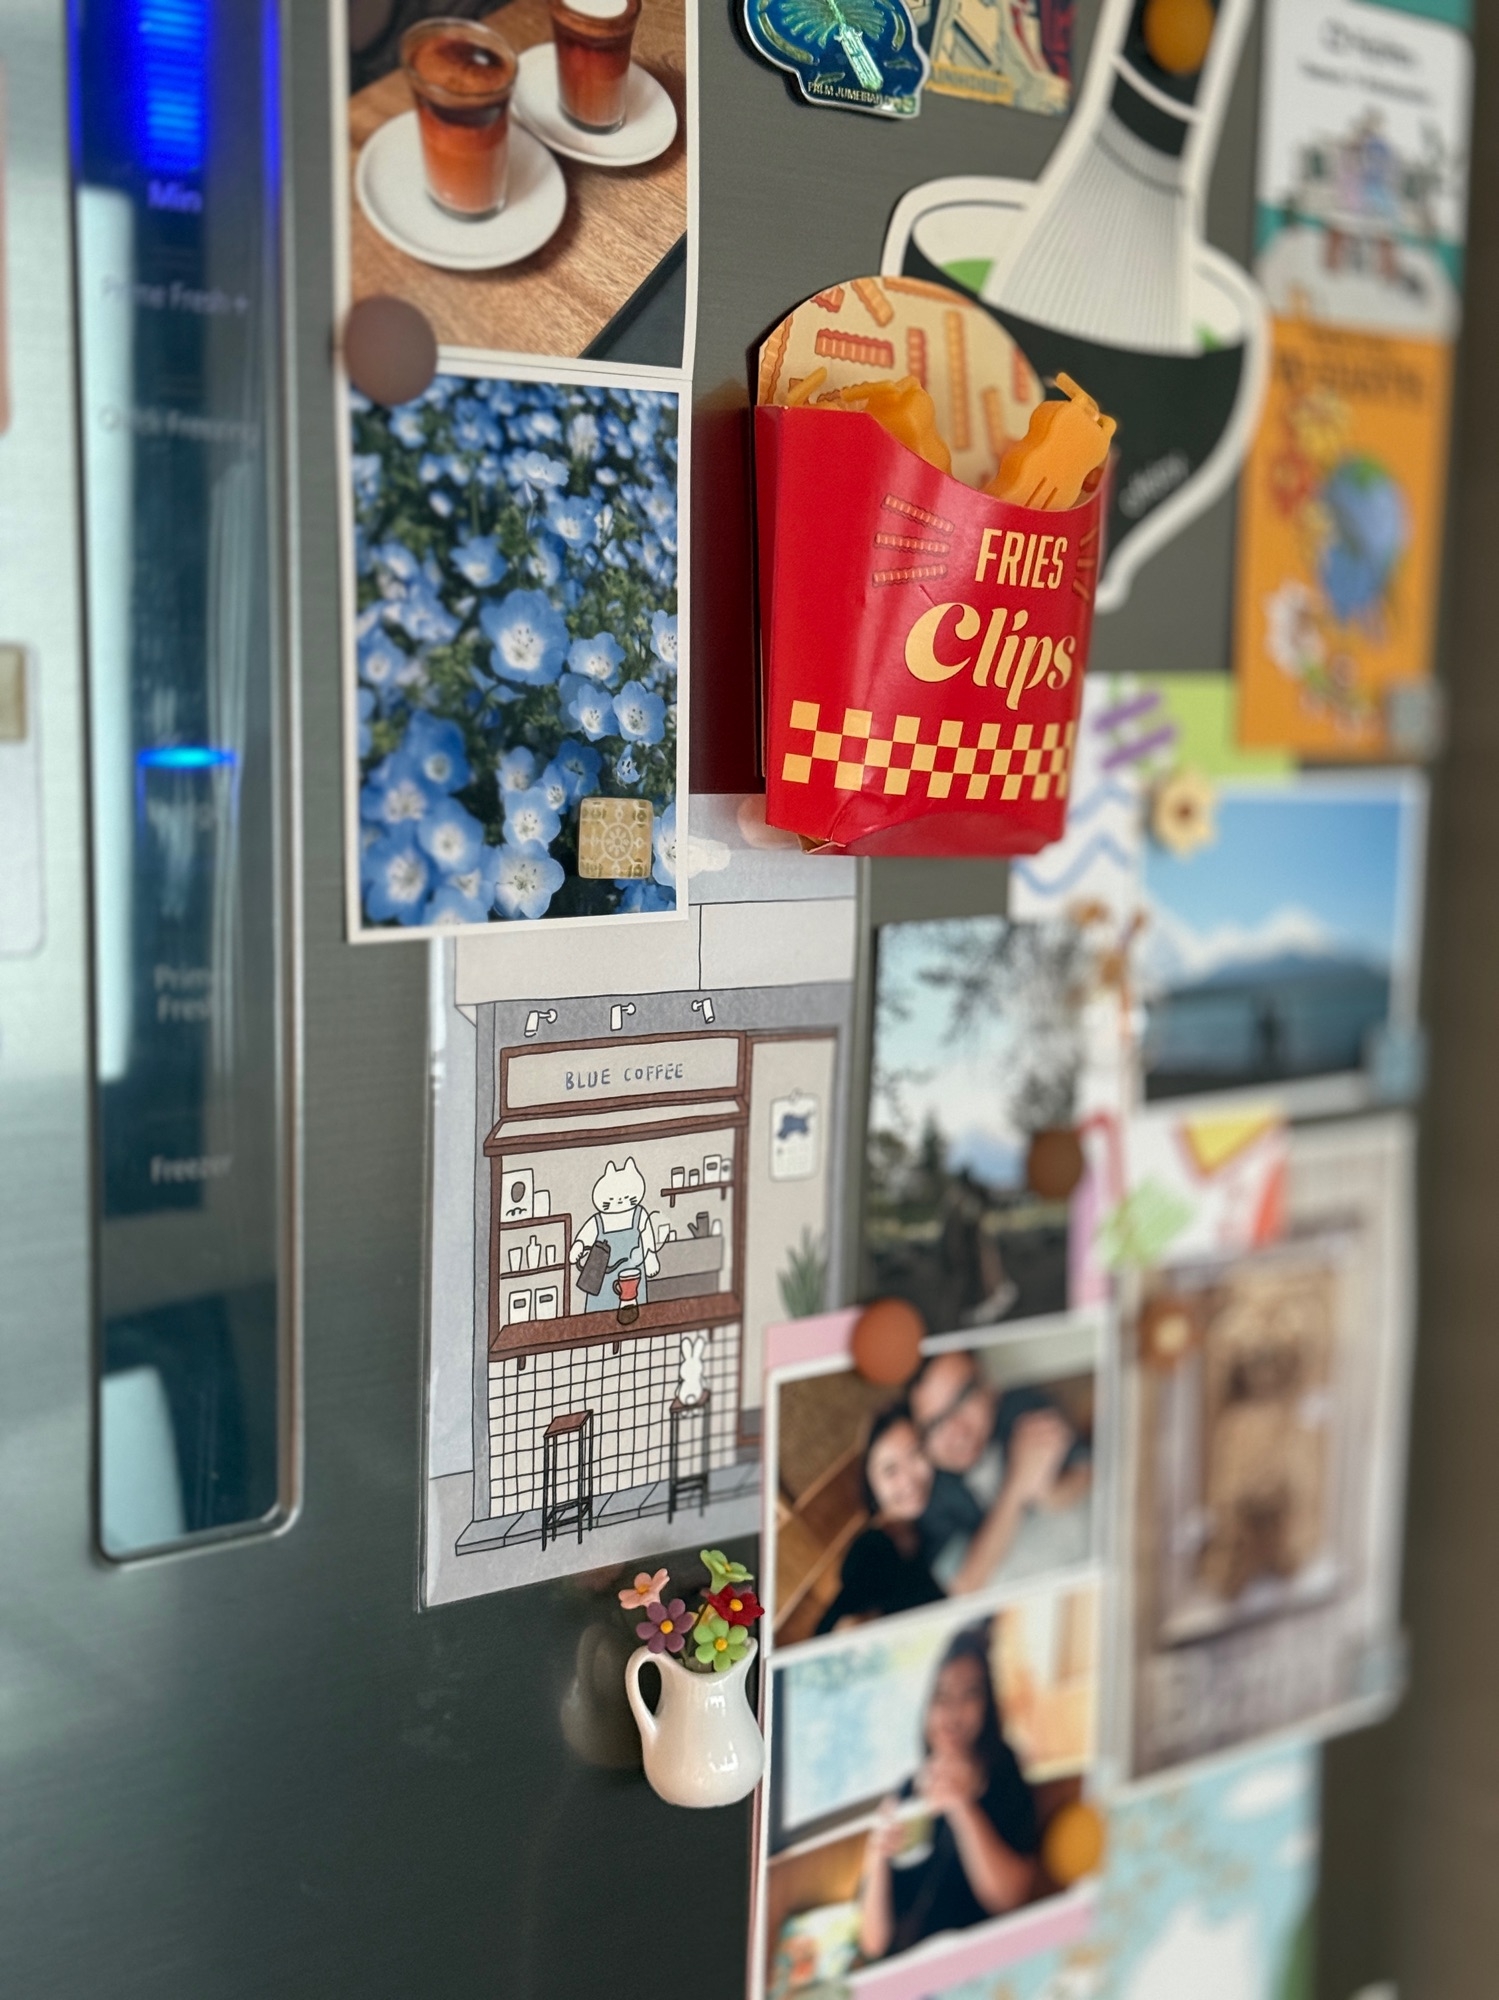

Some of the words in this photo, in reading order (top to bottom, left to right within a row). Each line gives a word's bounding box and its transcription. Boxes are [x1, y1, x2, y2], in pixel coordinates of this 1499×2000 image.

[807, 81, 834, 96] PALM
[147, 179, 203, 214] Min
[974, 527, 1068, 589] FRIES
[904, 602, 1076, 710] Clips
[565, 1068, 611, 1091] BLUE
[623, 1062, 684, 1082] COFFEE
